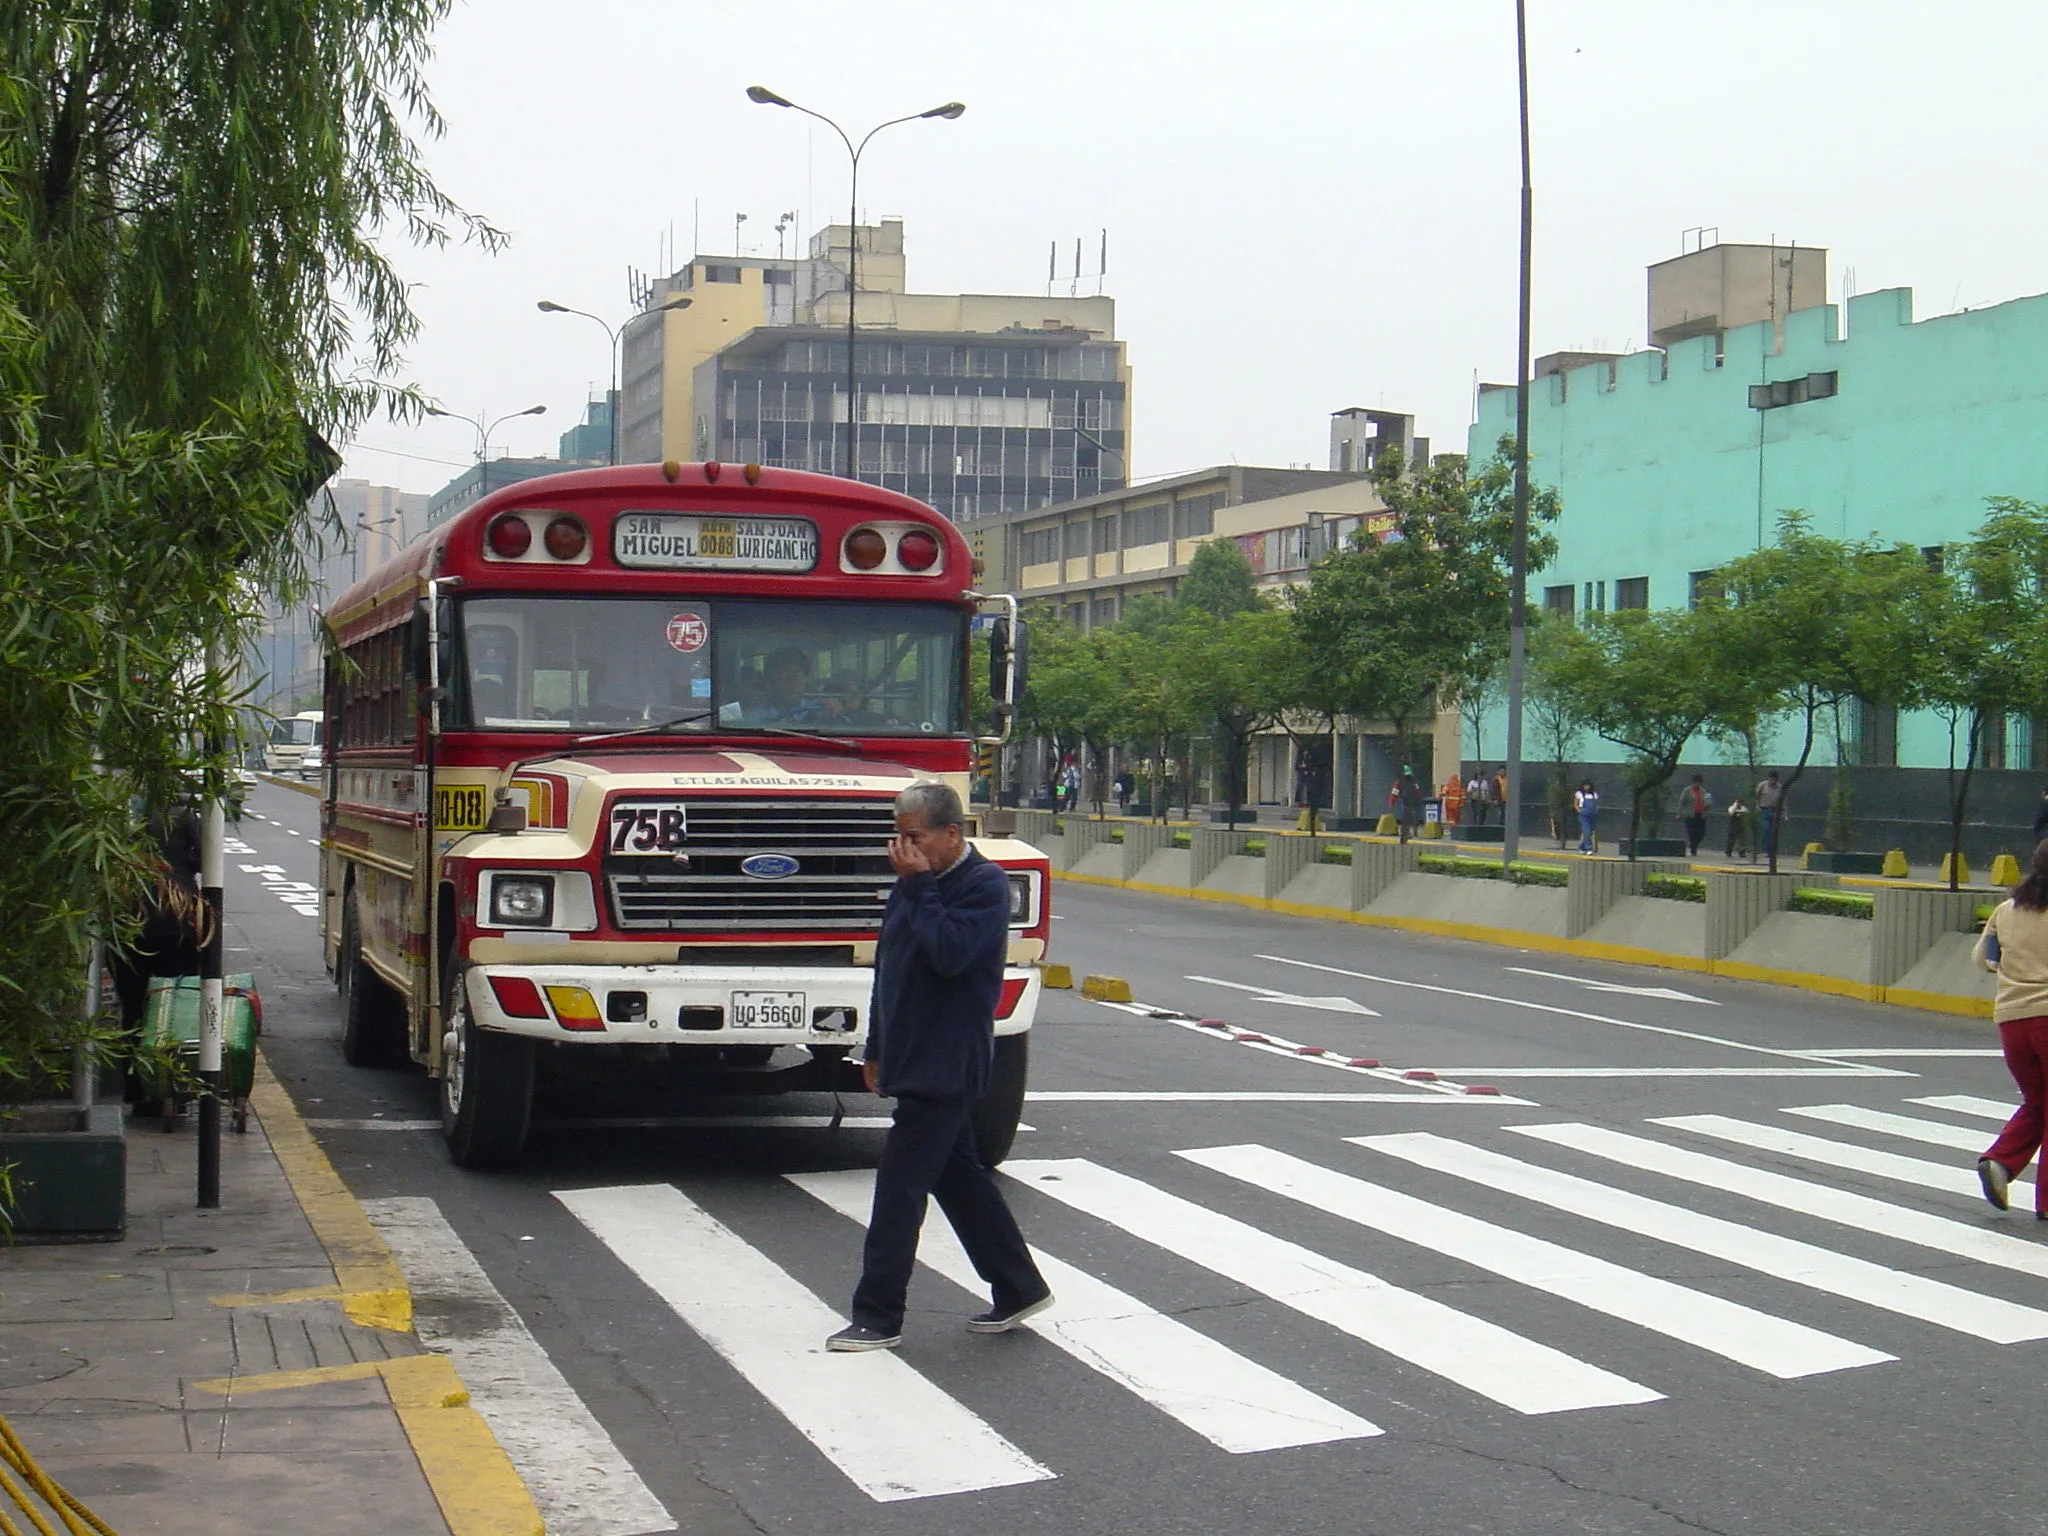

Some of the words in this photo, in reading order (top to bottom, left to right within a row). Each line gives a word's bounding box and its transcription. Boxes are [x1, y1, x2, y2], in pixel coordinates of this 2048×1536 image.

[629, 518, 663, 534] SAN
[736, 521, 766, 536] SAN
[767, 523, 808, 538] JUAN
[622, 535, 697, 557] MIGUEL
[671, 620, 703, 645] 75
[740, 777, 809, 786] AGUILAS
[612, 808, 687, 853] 75B
[754, 859, 787, 873] Ford
